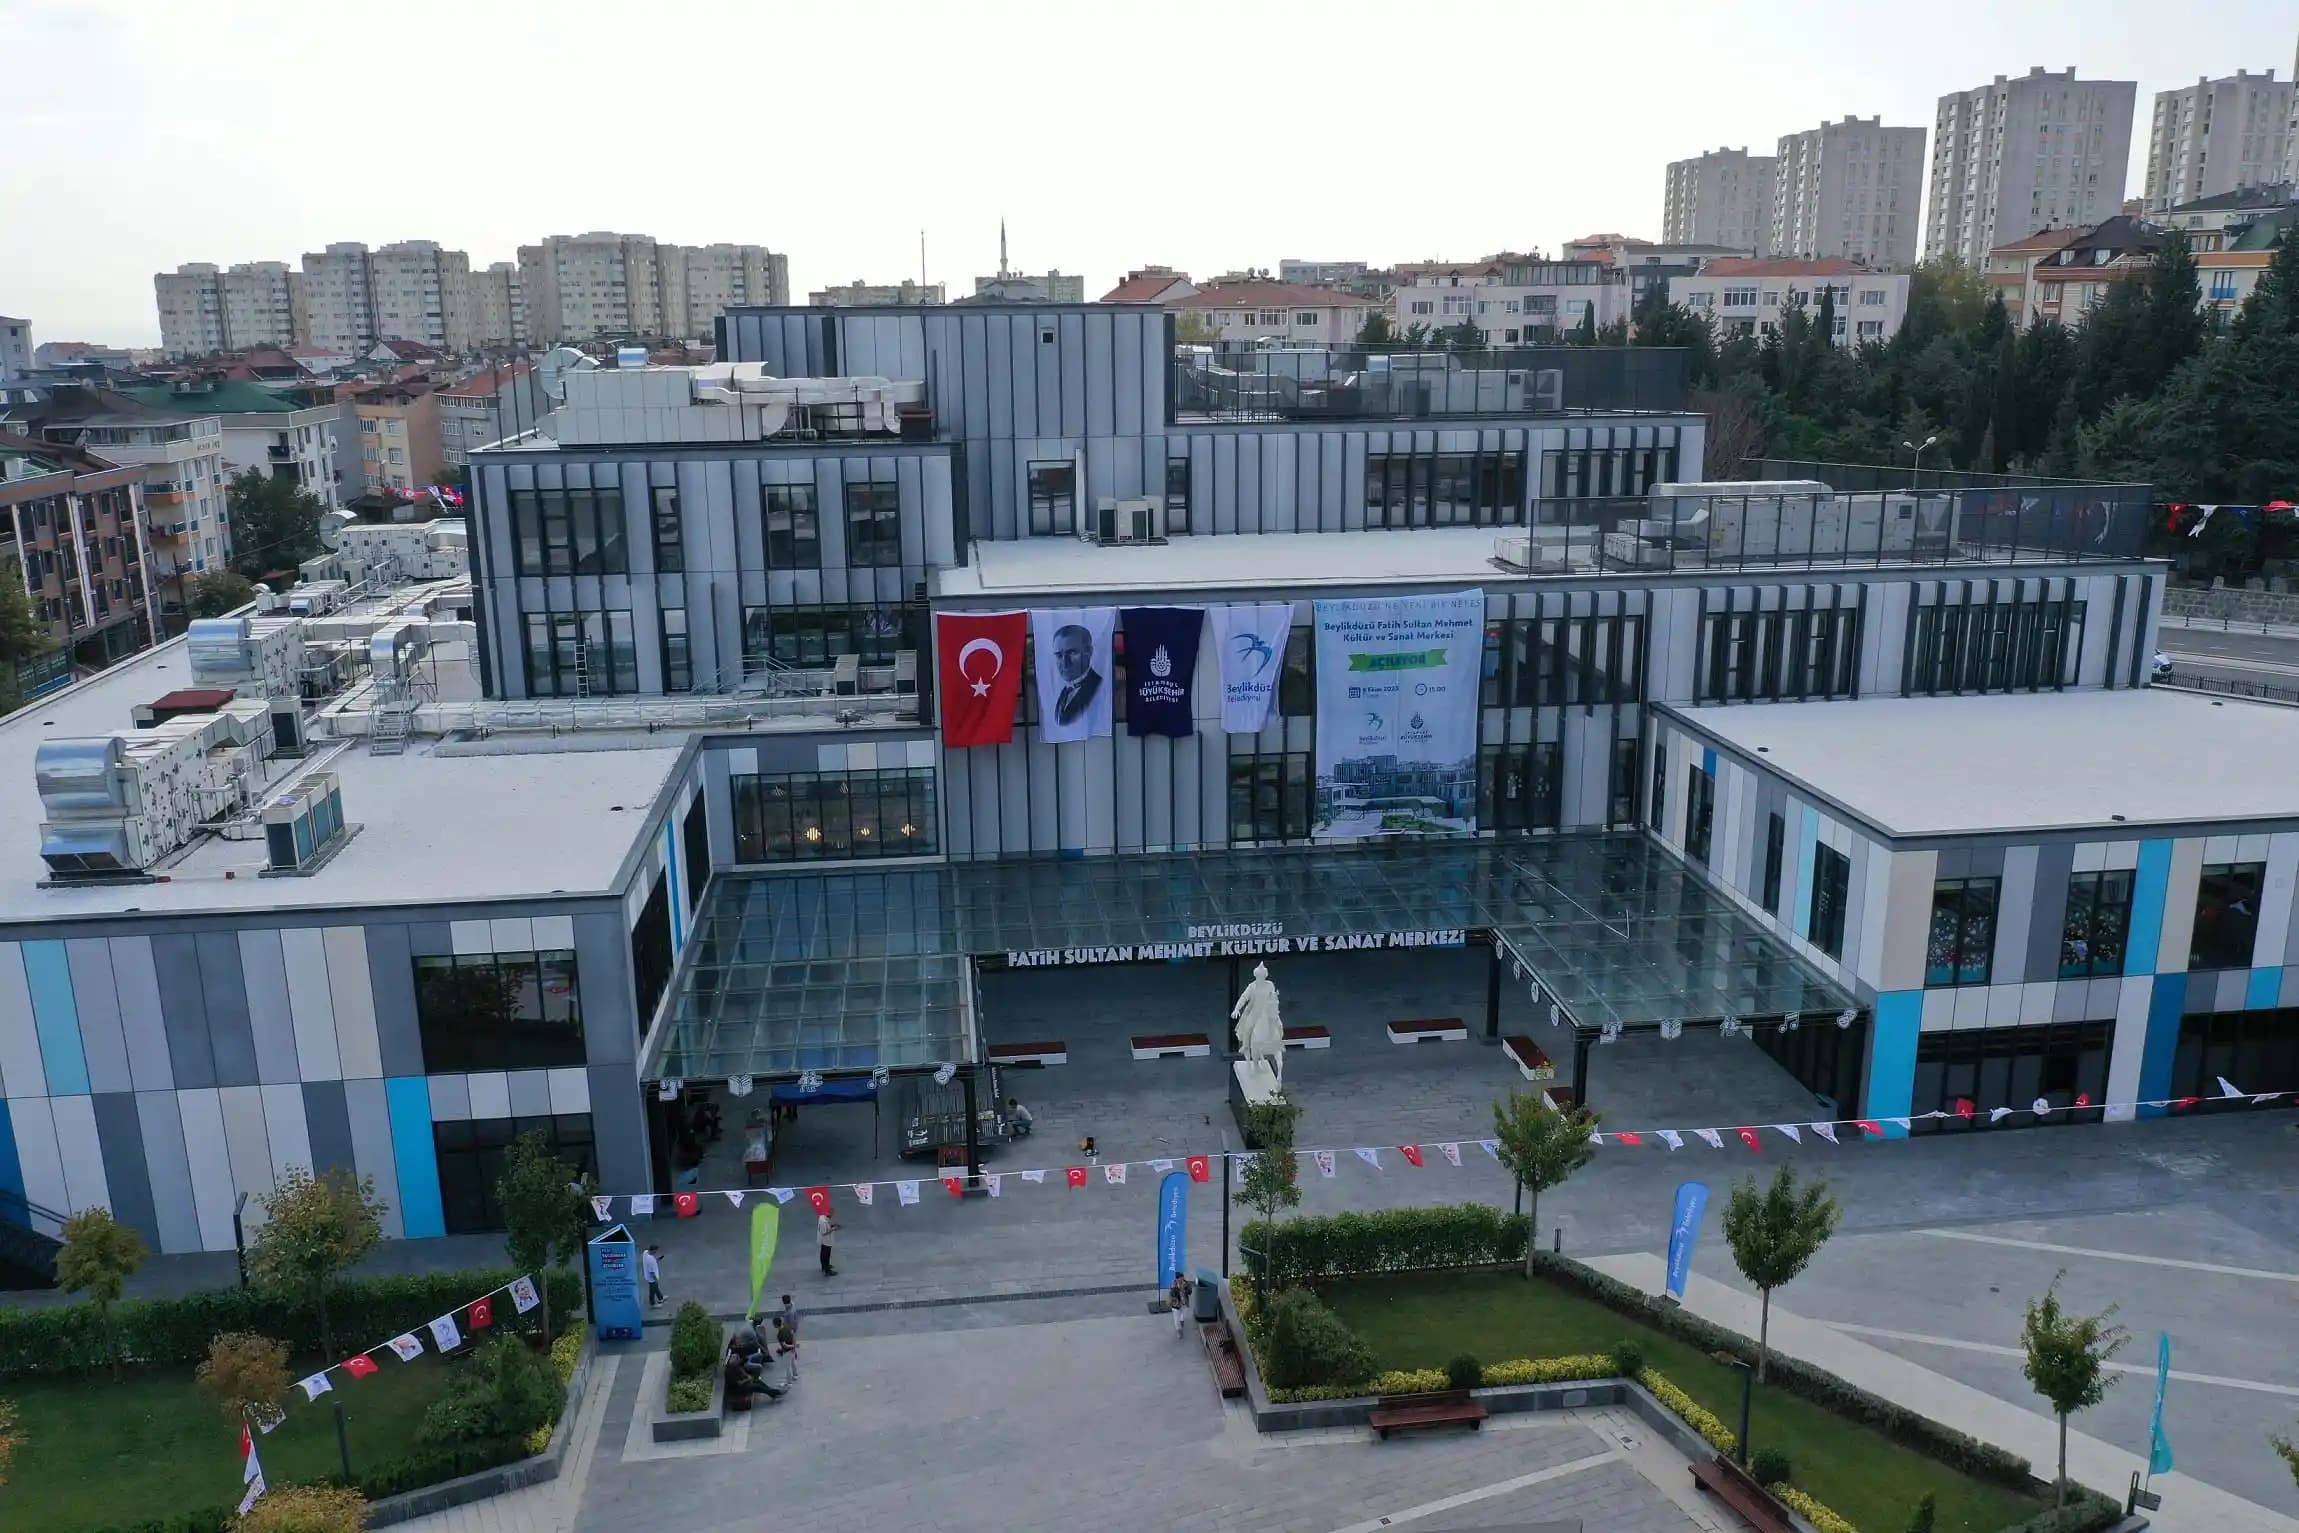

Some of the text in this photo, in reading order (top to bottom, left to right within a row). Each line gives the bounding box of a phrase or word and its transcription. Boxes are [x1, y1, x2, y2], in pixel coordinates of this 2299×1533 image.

[1325, 618, 1473, 632] Beylikdüzü Fatih Sultan Mehmet
[1343, 633, 1372, 642] Kültür
[1388, 632, 1414, 641] Sanat
[1227, 682, 1272, 694] Beylikdüz
[1188, 922, 1284, 938] BEYLİKDÜZÜ
[1008, 929, 1465, 967] FATİH SULTAN MEHMET KÜLTÜR VE SANAT MERKEZİ
